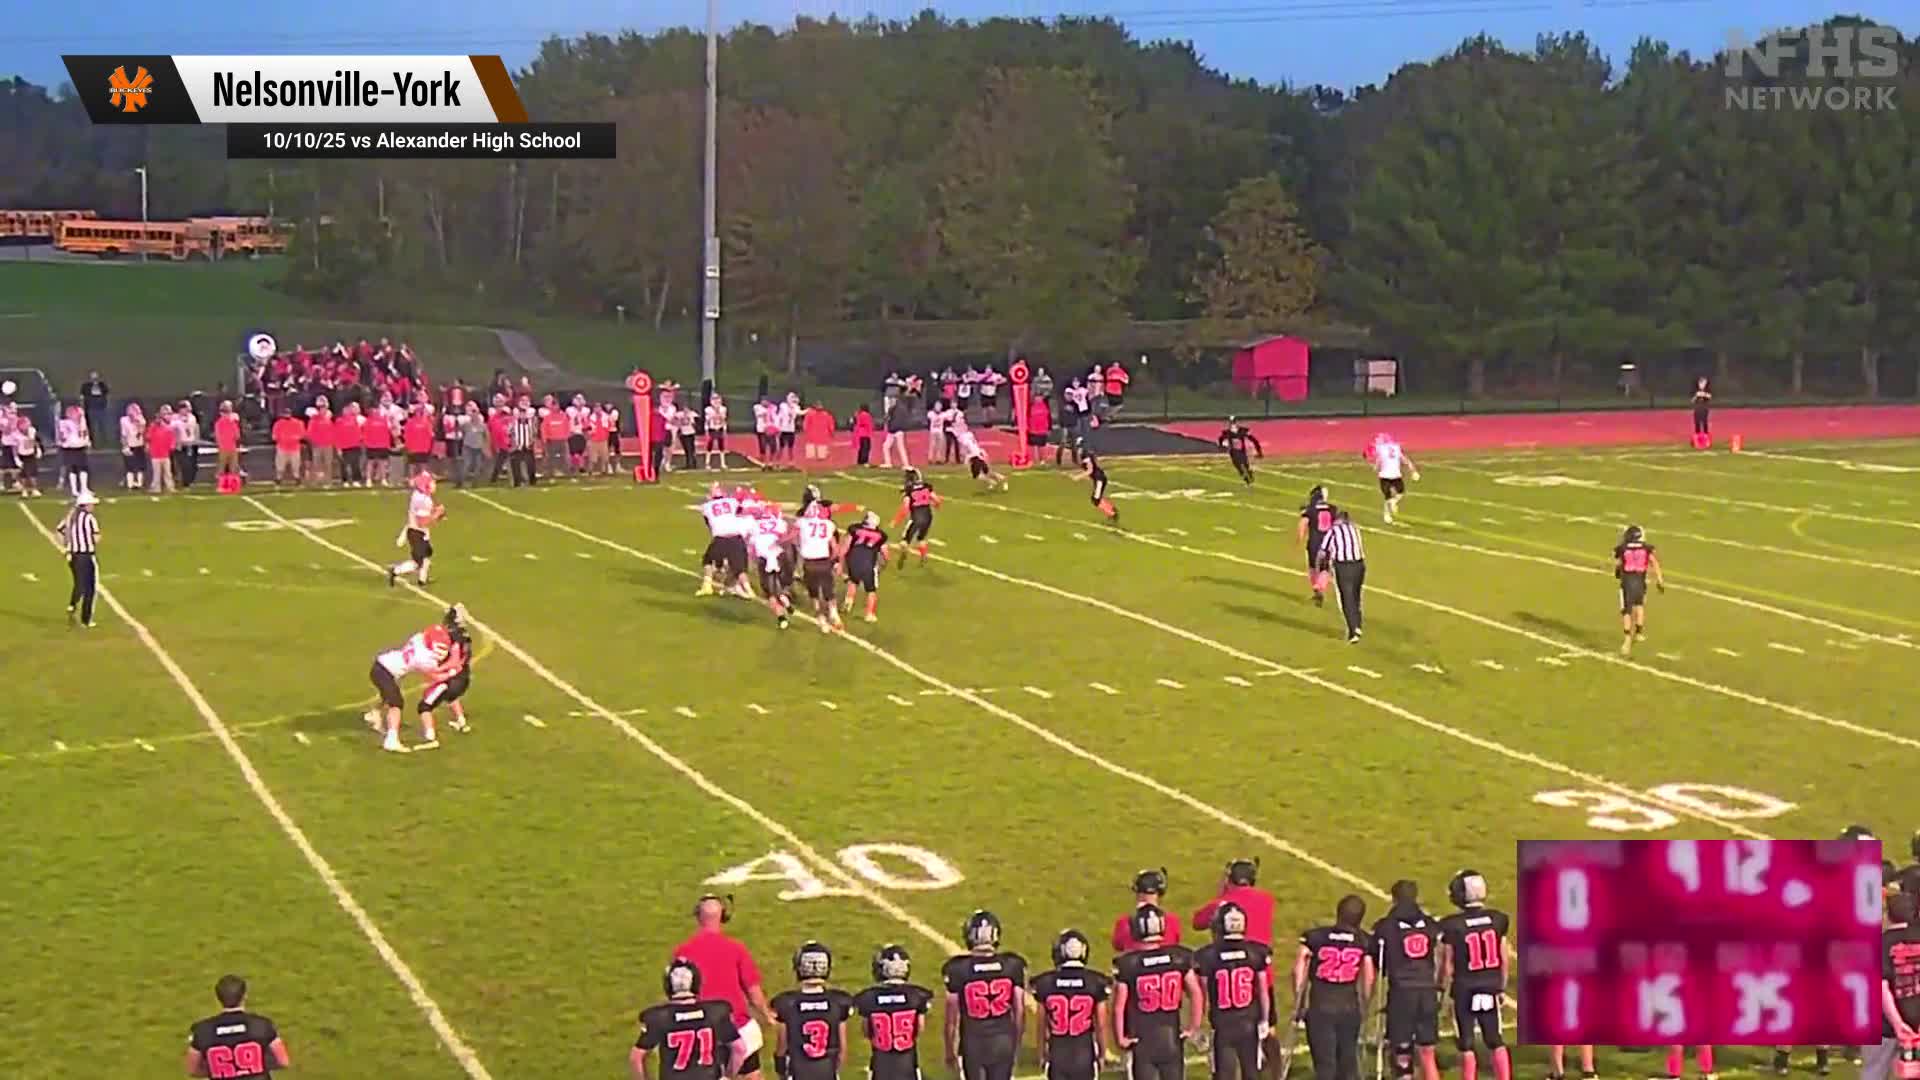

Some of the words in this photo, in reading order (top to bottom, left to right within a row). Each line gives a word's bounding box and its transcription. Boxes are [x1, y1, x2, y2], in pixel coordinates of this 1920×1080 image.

[808, 523, 828, 539] 73
[1532, 782, 1799, 832] 30
[701, 842, 966, 902] 40
[1317, 946, 1363, 983] 22
[1465, 929, 1499, 971] 11
[963, 978, 1014, 1019] 62
[1136, 971, 1184, 1013] 50
[1215, 967, 1255, 1009] 16
[1046, 995, 1094, 1036] 32
[207, 1041, 264, 1078] 69
[667, 1028, 714, 1071] 71
[802, 1020, 830, 1059] 3
